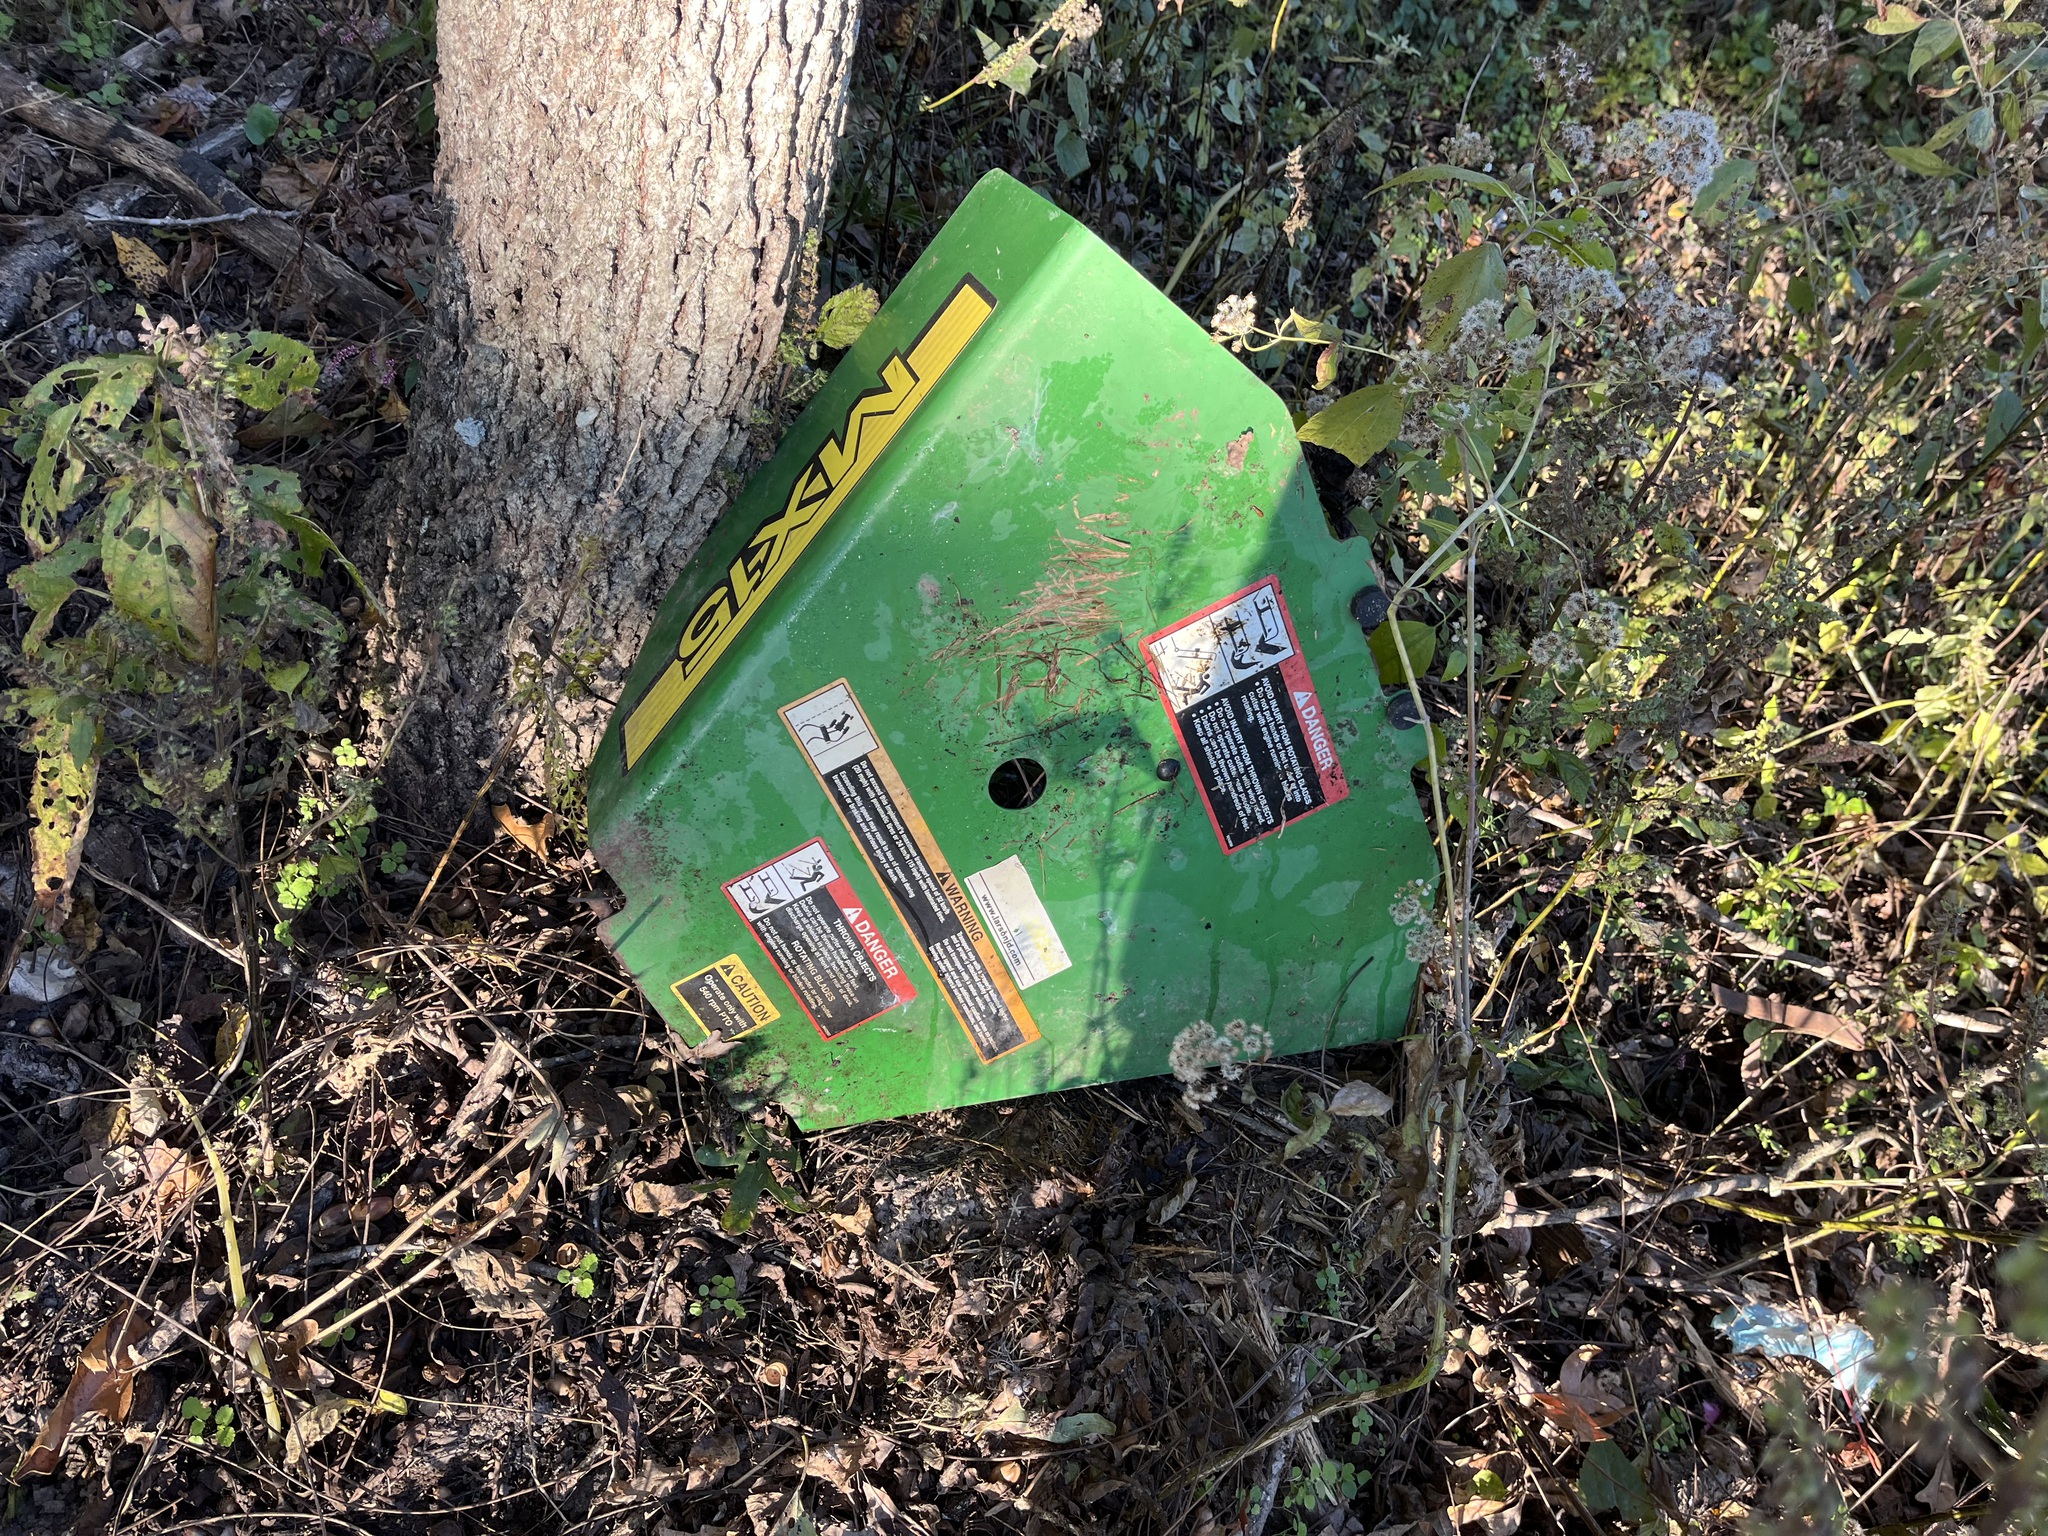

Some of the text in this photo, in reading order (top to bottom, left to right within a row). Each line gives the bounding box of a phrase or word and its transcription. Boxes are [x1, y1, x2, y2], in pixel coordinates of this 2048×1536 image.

[1256, 686, 1264, 698] Do
[1215, 706, 1224, 718] Do
[1239, 694, 1255, 723] rotating.
[1260, 697, 1269, 710] not
[1207, 710, 1217, 721] Do
[1219, 717, 1228, 730] not
[1248, 690, 1274, 749] cutter with engine
[1263, 709, 1273, 722] put
[1191, 718, 1204, 737] Keep
[1200, 714, 1213, 736] Debris
[1212, 721, 1221, 733] not
[1260, 676, 1274, 699] AVOID
[1268, 698, 1283, 726] INJURY
[1277, 724, 1291, 746] FROM
[1285, 745, 1302, 779] ROTATING
[1268, 721, 1280, 742] hands
[1199, 735, 1208, 745] all
[1215, 733, 1231, 759] operate
[1222, 729, 1238, 756] operate
[1276, 742, 1282, 750] or
[1300, 705, 1334, 771] DANGER
[1203, 745, 1217, 768] shields
[1214, 749, 1222, 759] be
[1220, 696, 1274, 824] AVOID INJURY FROM THROWN OBJECTS
[1279, 749, 1288, 763] feet
[1212, 767, 1220, 775] in
[1217, 758, 1231, 781] thrown
[1293, 788, 1302, 802] into
[1237, 809, 1245, 817] of
[790, 902, 804, 918] Keep
[943, 882, 984, 942] WARNING
[762, 916, 772, 926] Do
[800, 916, 809, 924] all
[768, 925, 778, 935] not
[804, 923, 820, 941] shields
[805, 895, 814, 905] Do
[810, 904, 820, 914] not
[815, 913, 832, 934] operate
[838, 948, 848, 959] near
[844, 958, 860, 977] people.
[979, 893, 1023, 966] www.larsonjd.com
[772, 934, 784, 944] put
[798, 899, 813, 917] Debris
[809, 916, 818, 927] can
[815, 925, 824, 934] be
[820, 933, 835, 951] thrown
[831, 950, 849, 973] hundreds
[849, 978, 860, 990] feet.
[780, 943, 794, 959] hands
[783, 905, 805, 932] discharge
[799, 930, 818, 952] opening
[817, 956, 829, 969] front
[825, 968, 835, 978] and
[831, 978, 841, 988] rear
[842, 993, 854, 1007] deck.
[831, 918, 877, 982] THROWN OBJECTS
[854, 919, 899, 979] DANGER
[755, 920, 767, 932] with
[762, 931, 779, 950] engine
[773, 948, 791, 969] running
[791, 973, 806, 990] blades
[800, 989, 818, 1009] rotating.
[790, 939, 835, 1002] ROTATING BLADES
[794, 964, 805, 975] feet
[801, 974, 814, 989] under
[843, 982, 856, 997] those
[698, 985, 733, 1027] 540 rpm PTO
[702, 973, 748, 1028] Operate only with
[729, 973, 771, 1021] CAUTION
[820, 1004, 833, 1018] cutter
